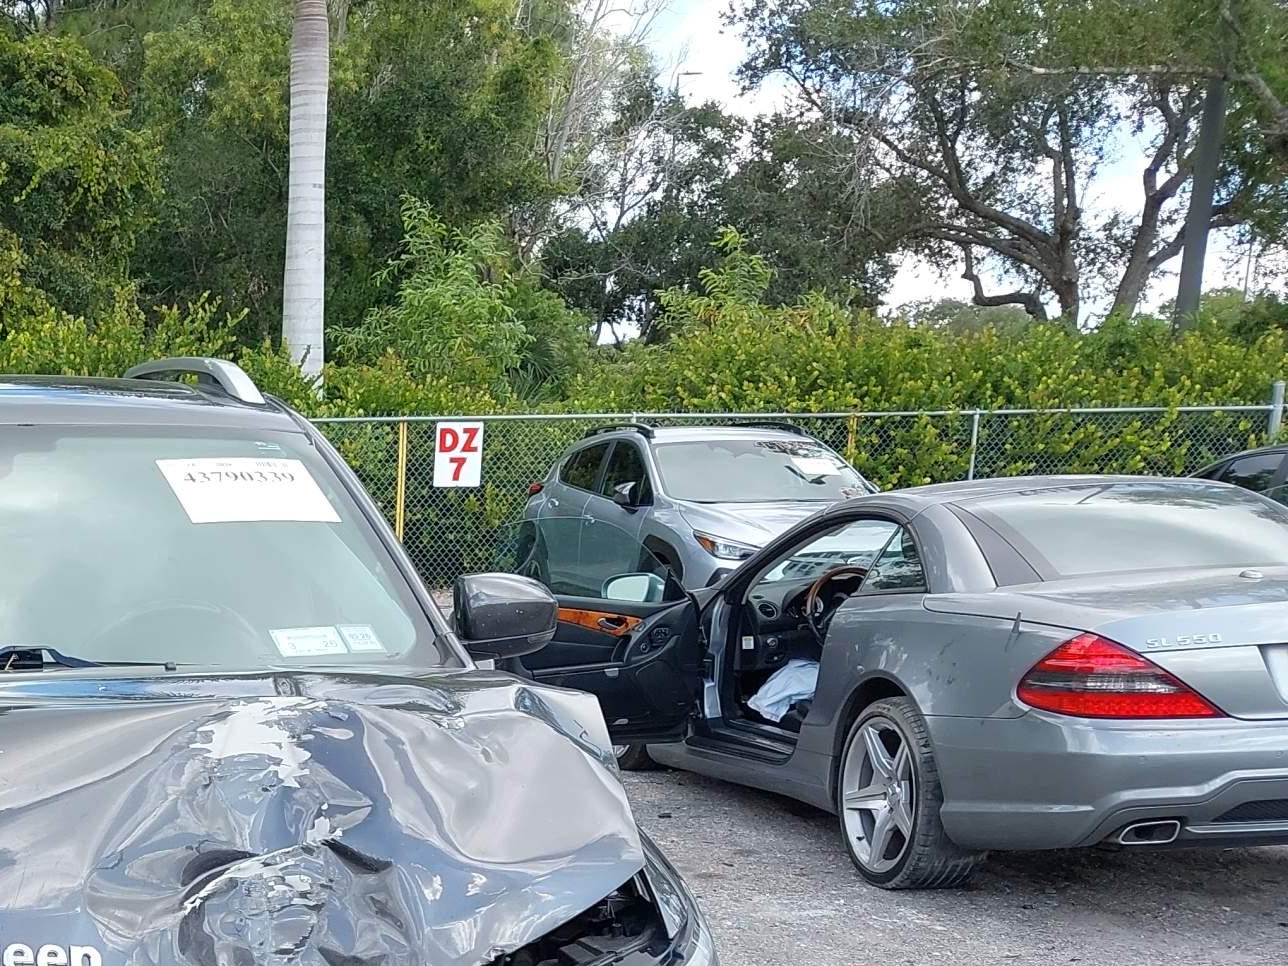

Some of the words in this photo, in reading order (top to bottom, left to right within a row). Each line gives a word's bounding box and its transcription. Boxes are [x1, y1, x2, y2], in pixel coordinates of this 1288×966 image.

[438, 427, 480, 453] DZ
[183, 471, 295, 483] 43790339
[448, 456, 468, 482] 7
